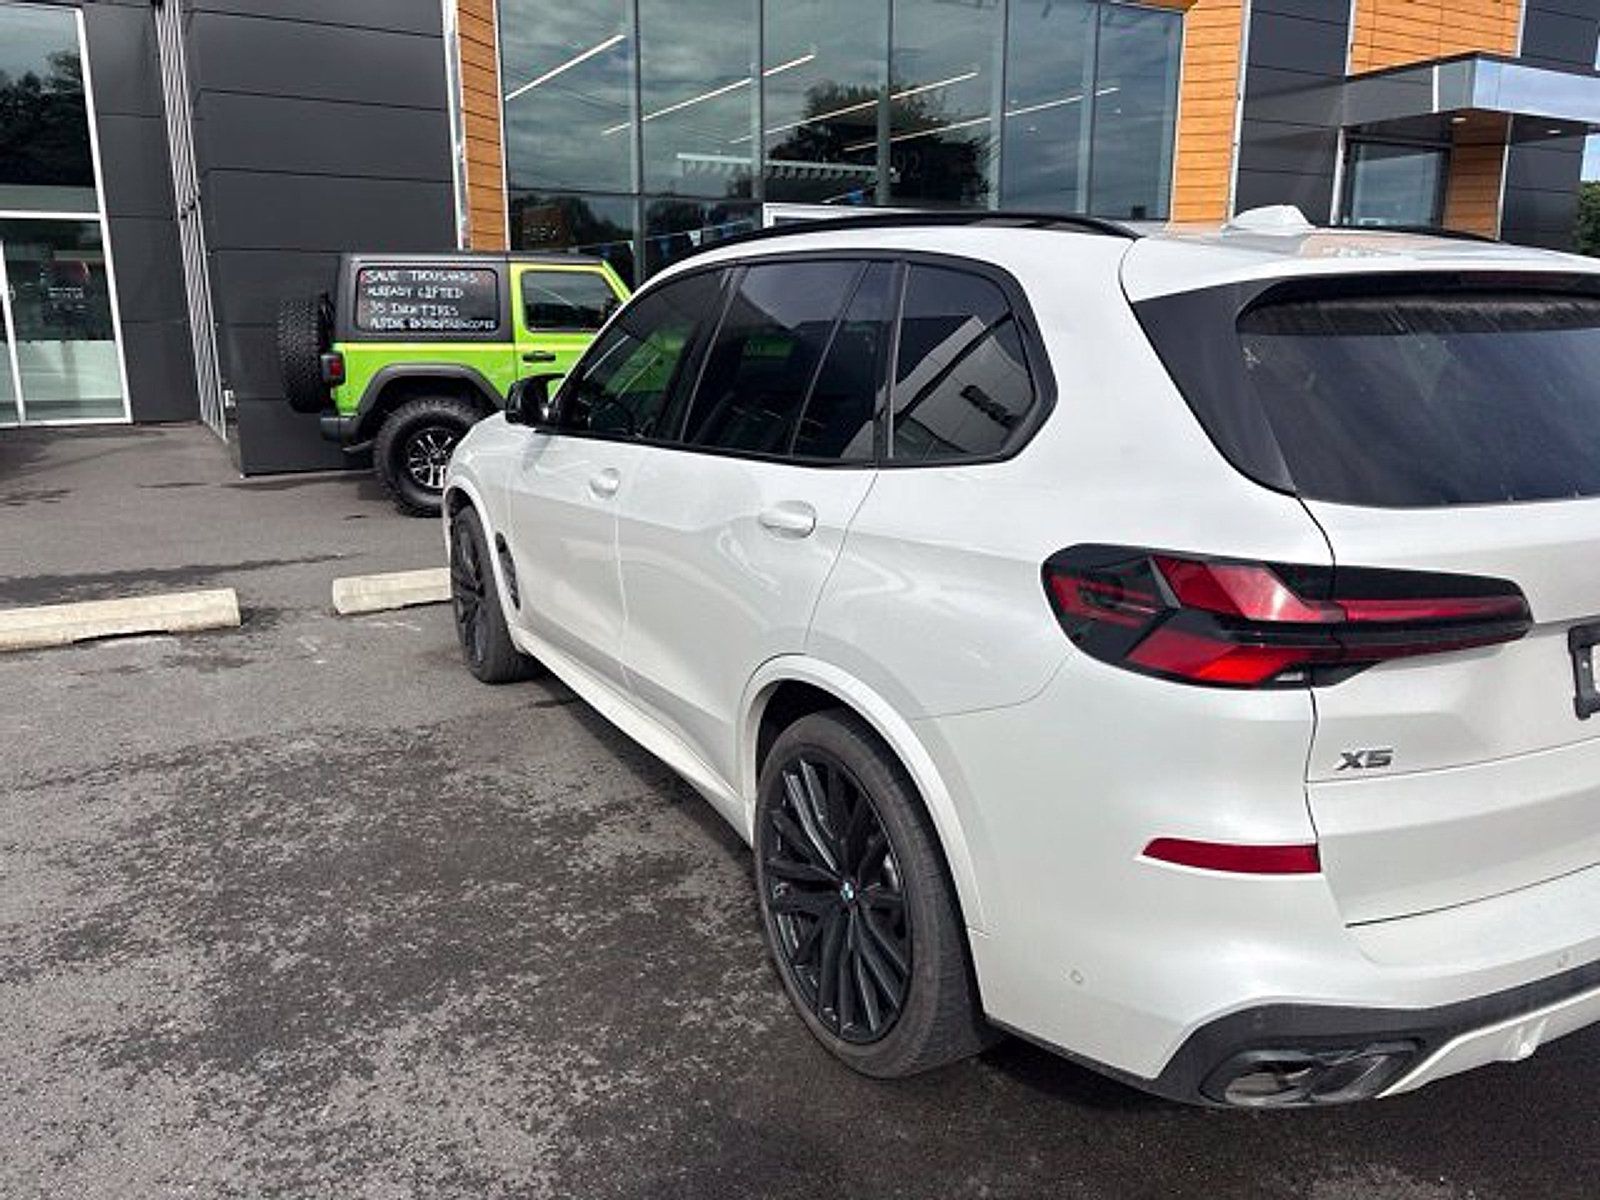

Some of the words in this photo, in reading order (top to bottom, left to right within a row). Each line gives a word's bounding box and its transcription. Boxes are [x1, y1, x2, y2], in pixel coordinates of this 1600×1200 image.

[365, 270, 398, 284] SAVE
[409, 270, 479, 284] THOUSANDS
[367, 286, 412, 298] ALREADY
[1335, 748, 1394, 771] X5
